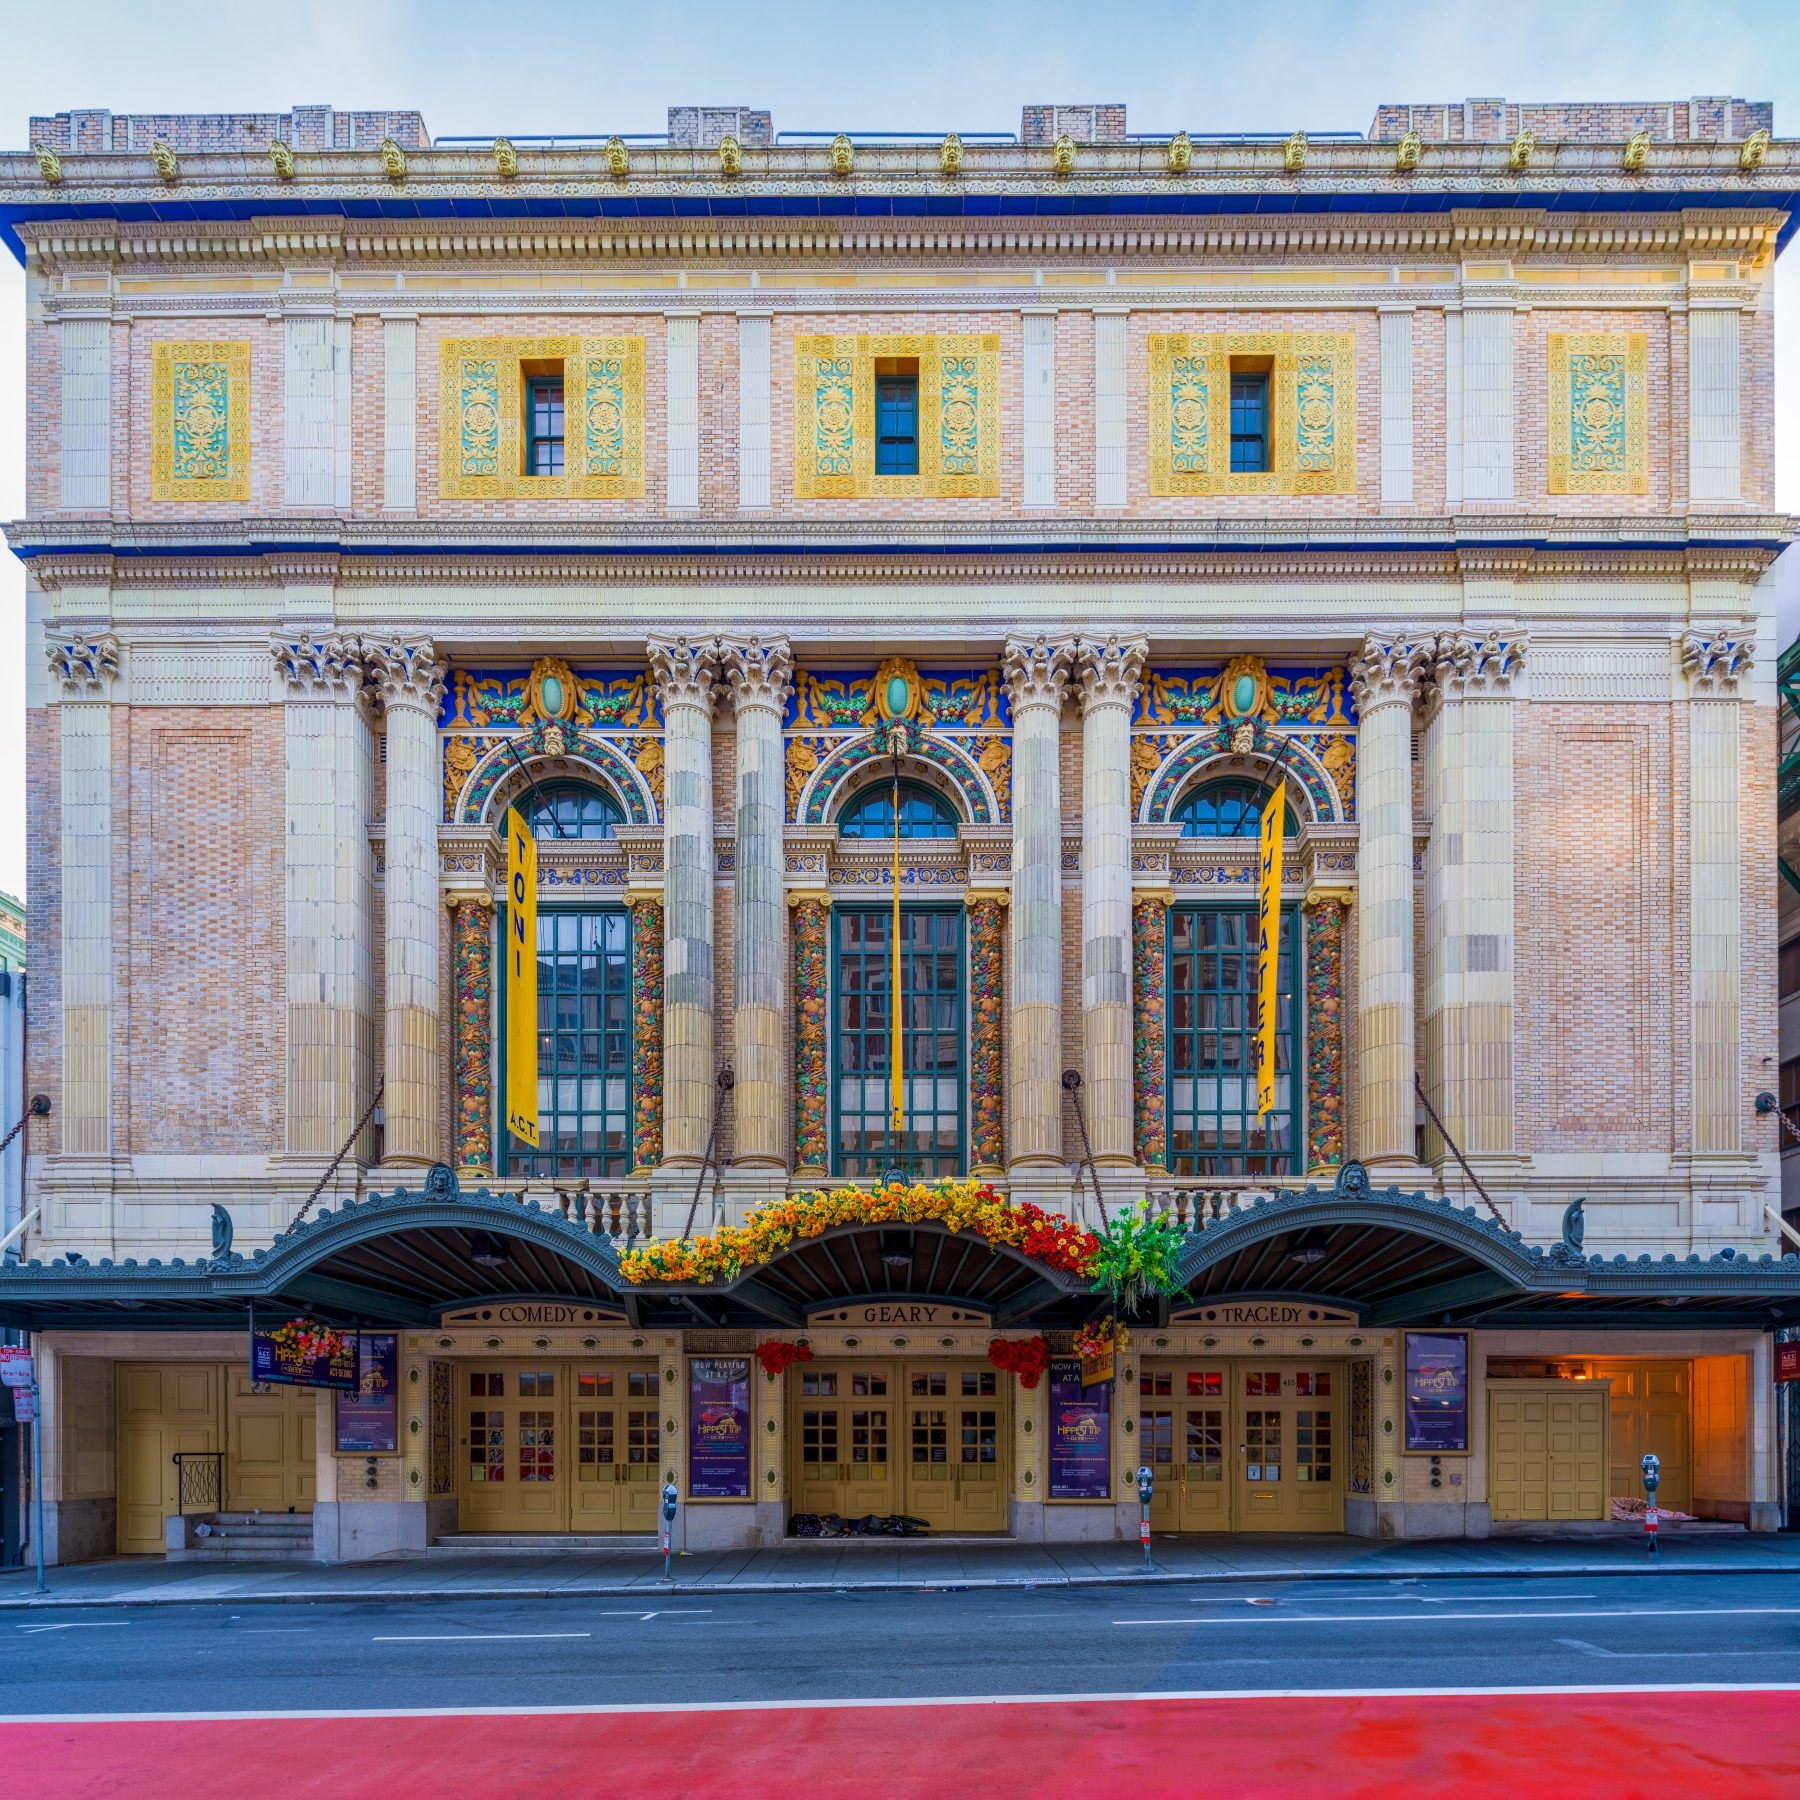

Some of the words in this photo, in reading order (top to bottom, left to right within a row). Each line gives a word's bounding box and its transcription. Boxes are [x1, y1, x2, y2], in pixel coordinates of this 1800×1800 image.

[514, 831, 525, 978] TONI
[1258, 807, 1277, 1067] THEATER
[510, 1110, 536, 1140] A.C.T.
[499, 1306, 578, 1323] COMEDY
[864, 1306, 938, 1323] GEARY
[1222, 1306, 1303, 1323] TRAGEDY
[695, 1361, 711, 1369] NOW
[714, 1361, 745, 1369] PLAYING
[1051, 1363, 1072, 1371] NOW
[1062, 1374, 1073, 1382] AT
[1282, 1379, 1296, 1387] 415
[697, 1424, 728, 1435] HIPPEST
[728, 1425, 742, 1434] TRIP
[1057, 1425, 1088, 1436] HIPPEST
[1088, 1425, 1102, 1435] TRIP
